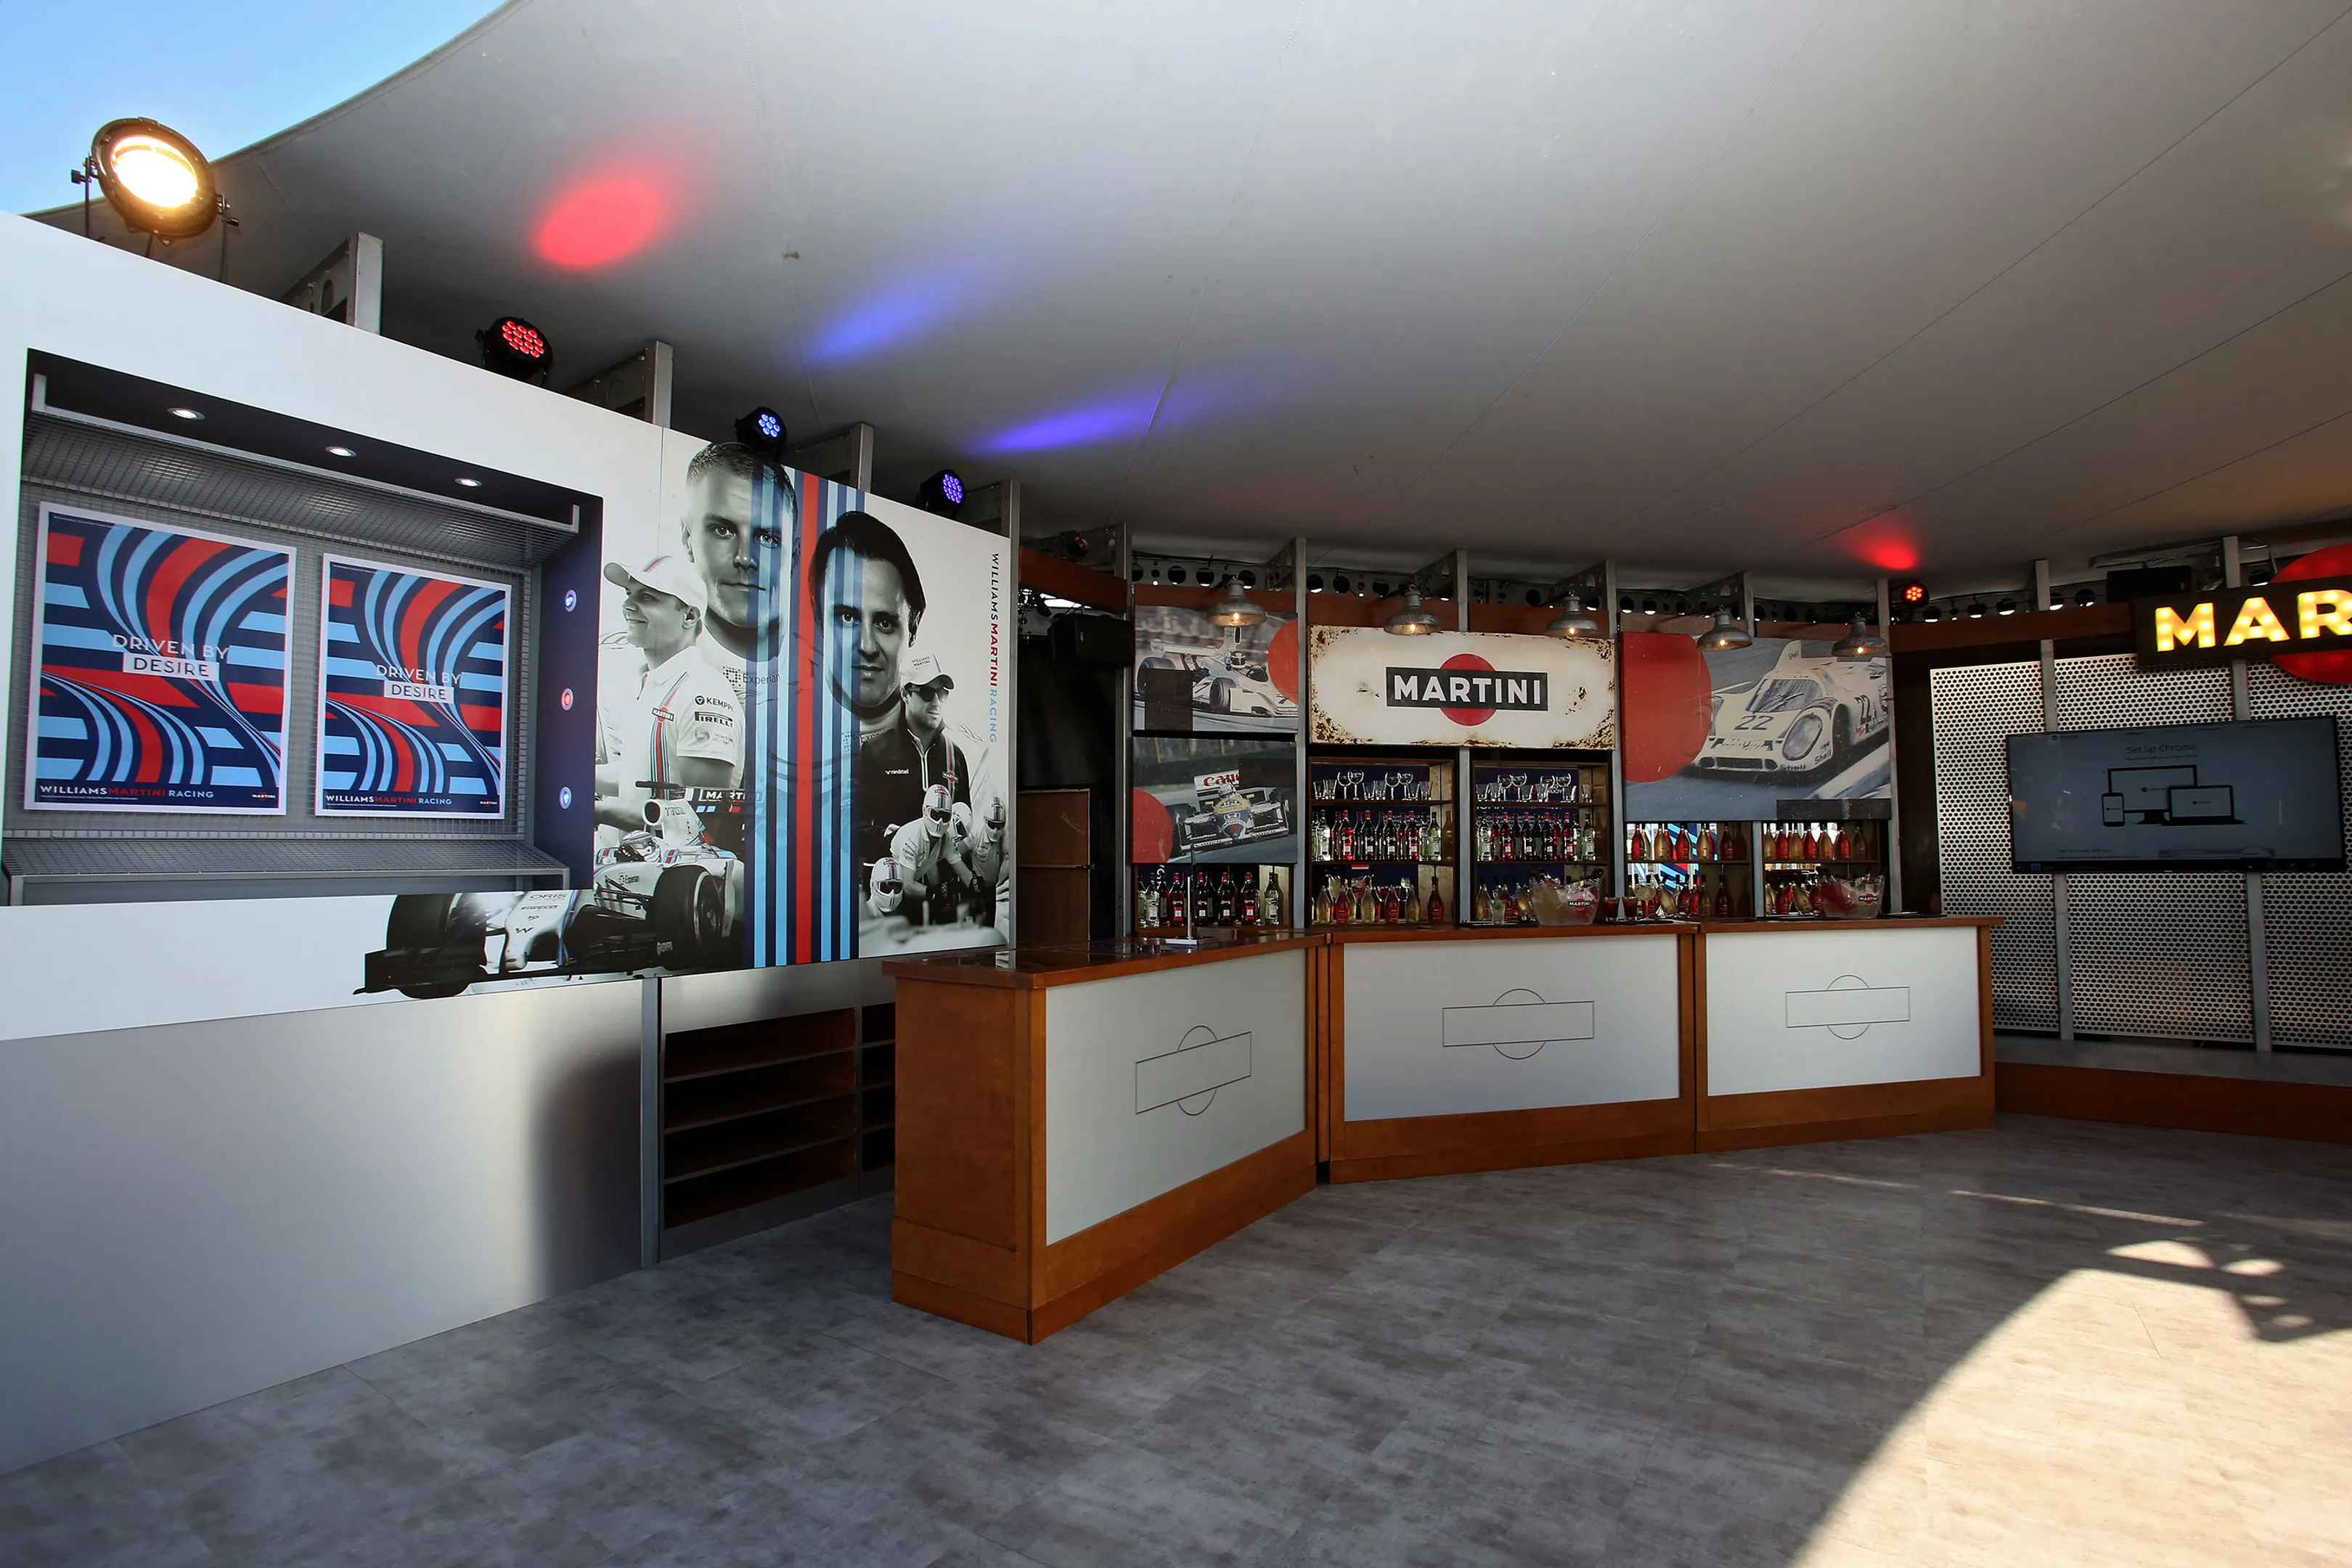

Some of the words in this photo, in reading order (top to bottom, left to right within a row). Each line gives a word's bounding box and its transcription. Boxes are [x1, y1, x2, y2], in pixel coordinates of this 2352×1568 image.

[990, 553, 999, 620] WILLIAMS
[113, 634, 195, 656] DRIVEN
[203, 645, 229, 659] BY
[134, 657, 209, 677] DESIRE
[376, 664, 436, 682] DRIVEN
[441, 672, 461, 684] BY
[743, 673, 781, 686] Experian
[392, 685, 446, 700] DESIRE
[1394, 674, 1540, 705] MARTINI
[706, 697, 733, 711] KEMPPI
[695, 711, 733, 727] PIRELLI
[1734, 715, 1773, 730] 22
[2126, 746, 2142, 754] Set
[39, 785, 107, 795] WILLIAMS
[108, 787, 166, 796] MARTINI
[168, 790, 214, 799] RACING
